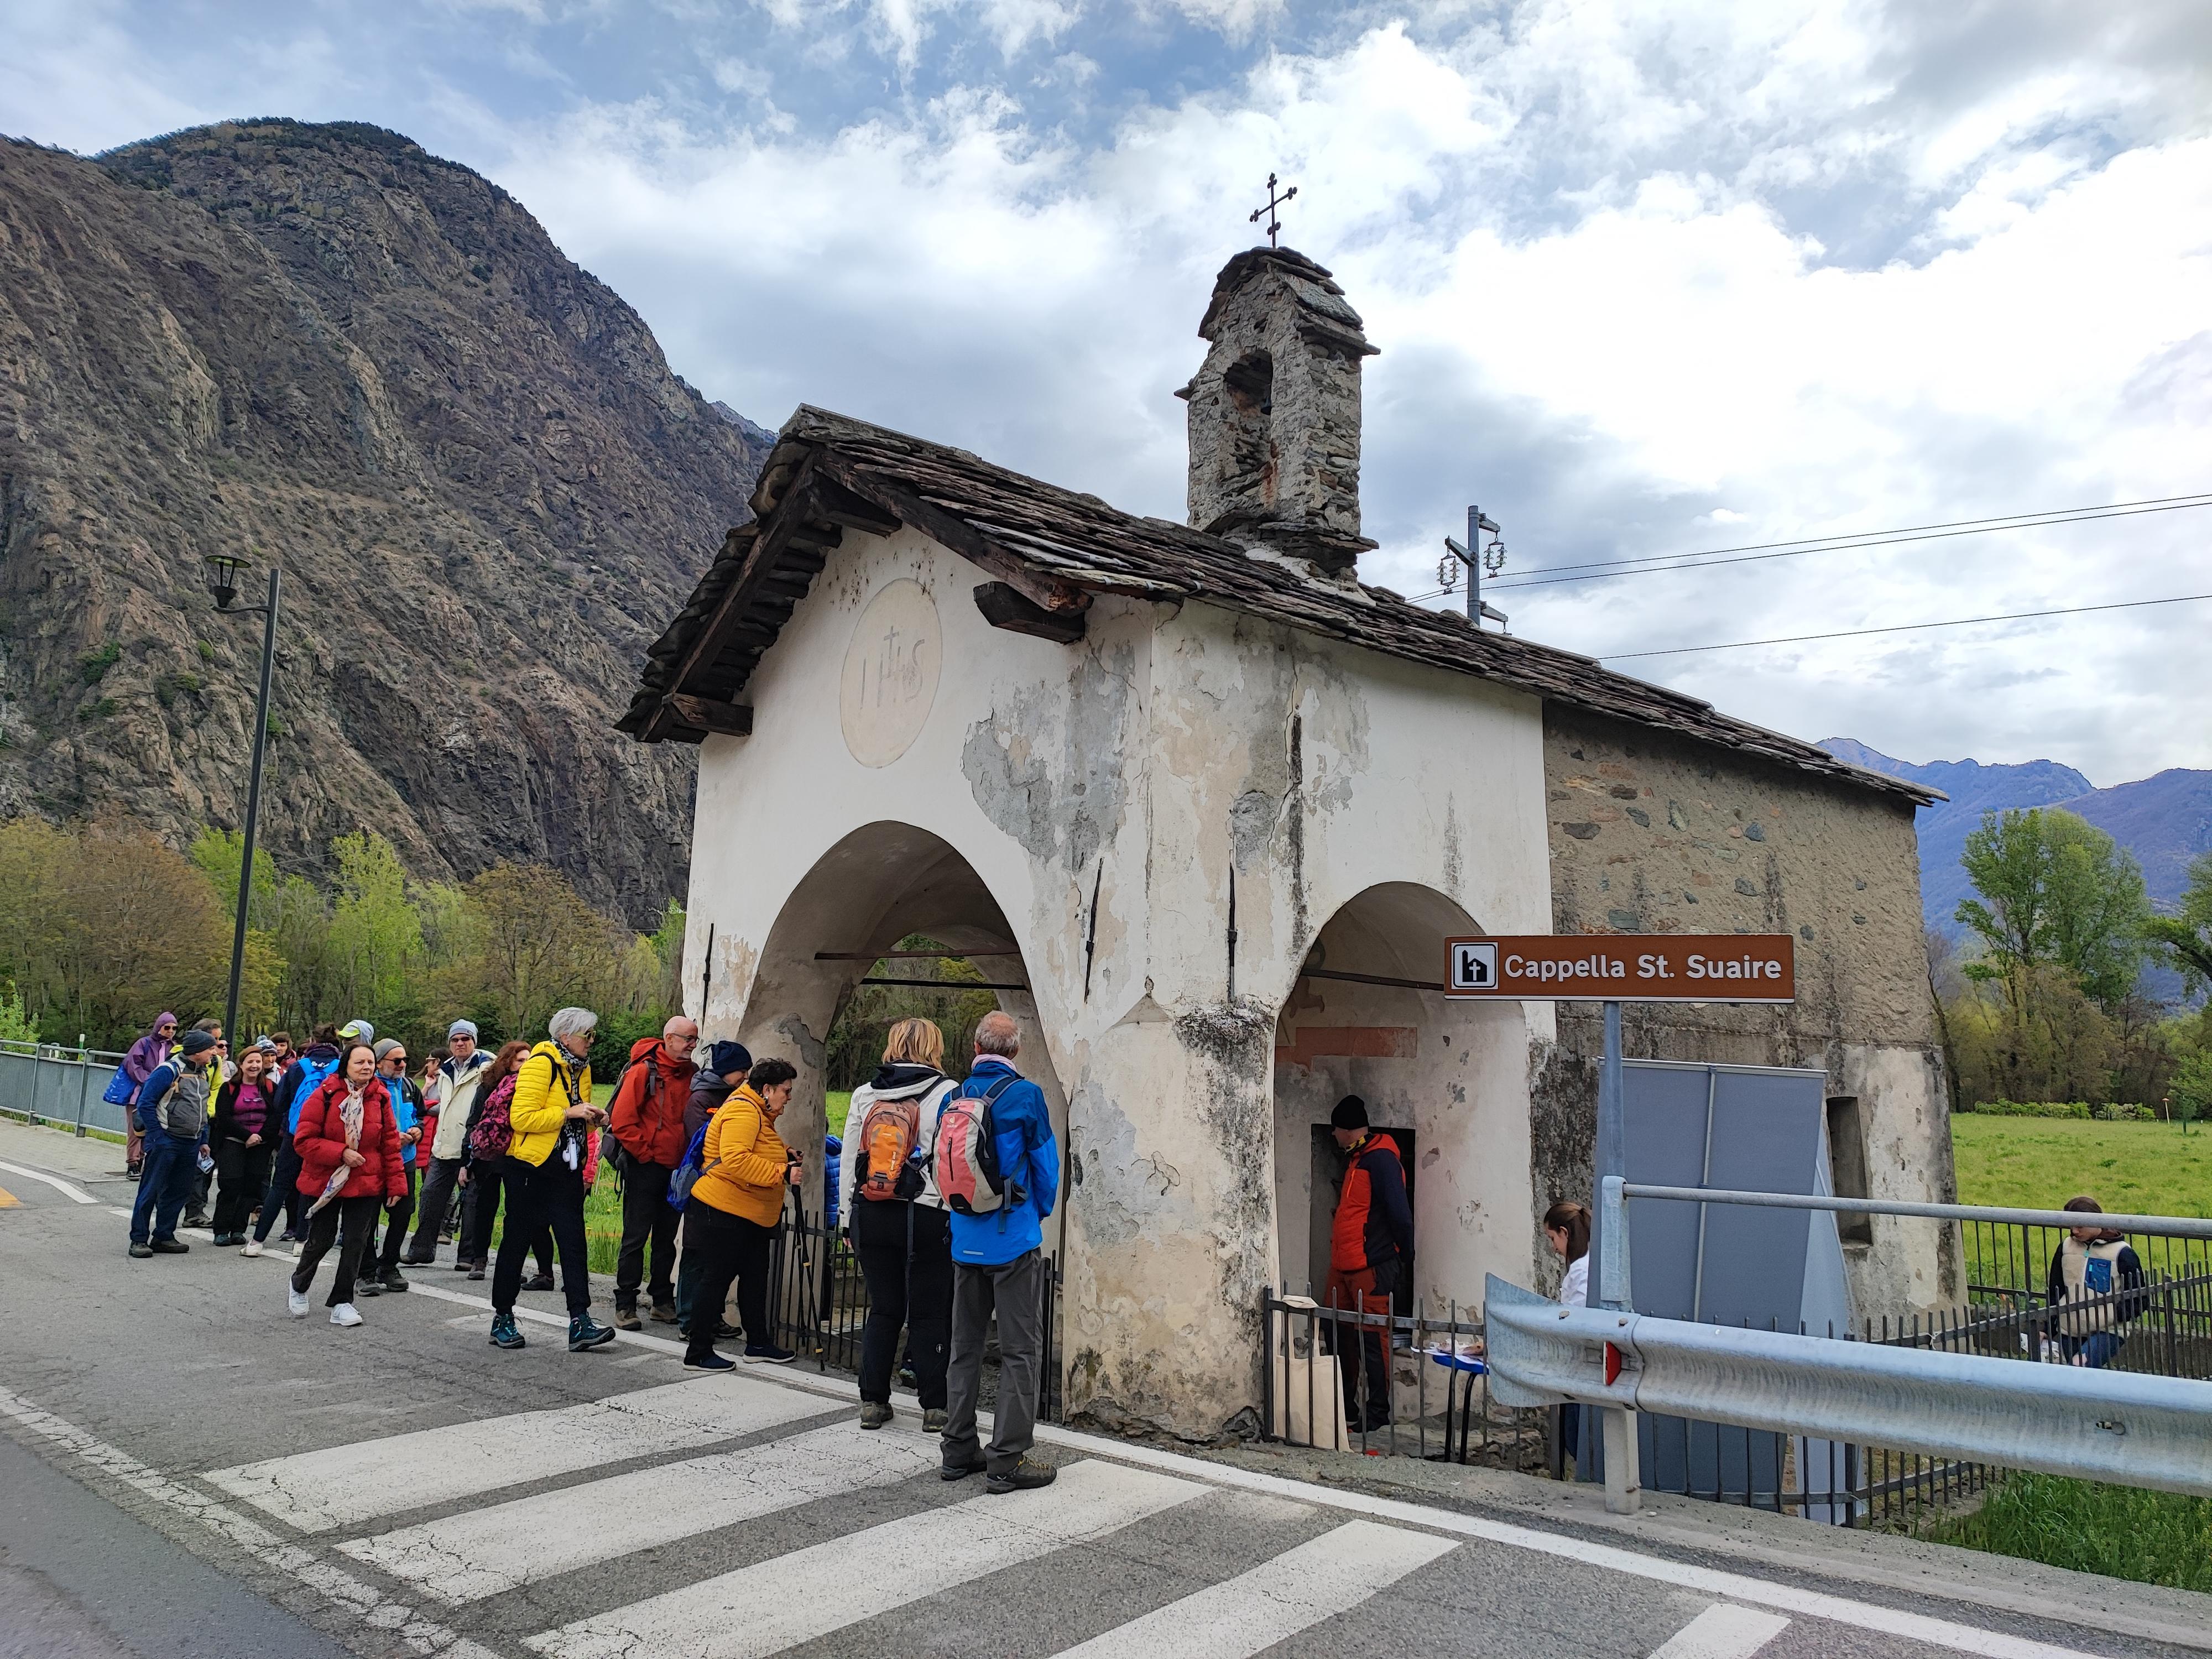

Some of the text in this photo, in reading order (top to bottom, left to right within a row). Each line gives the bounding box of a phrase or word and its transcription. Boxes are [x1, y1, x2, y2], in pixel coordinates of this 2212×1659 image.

[1504, 954, 1782, 983] Cappella St. Suaire
